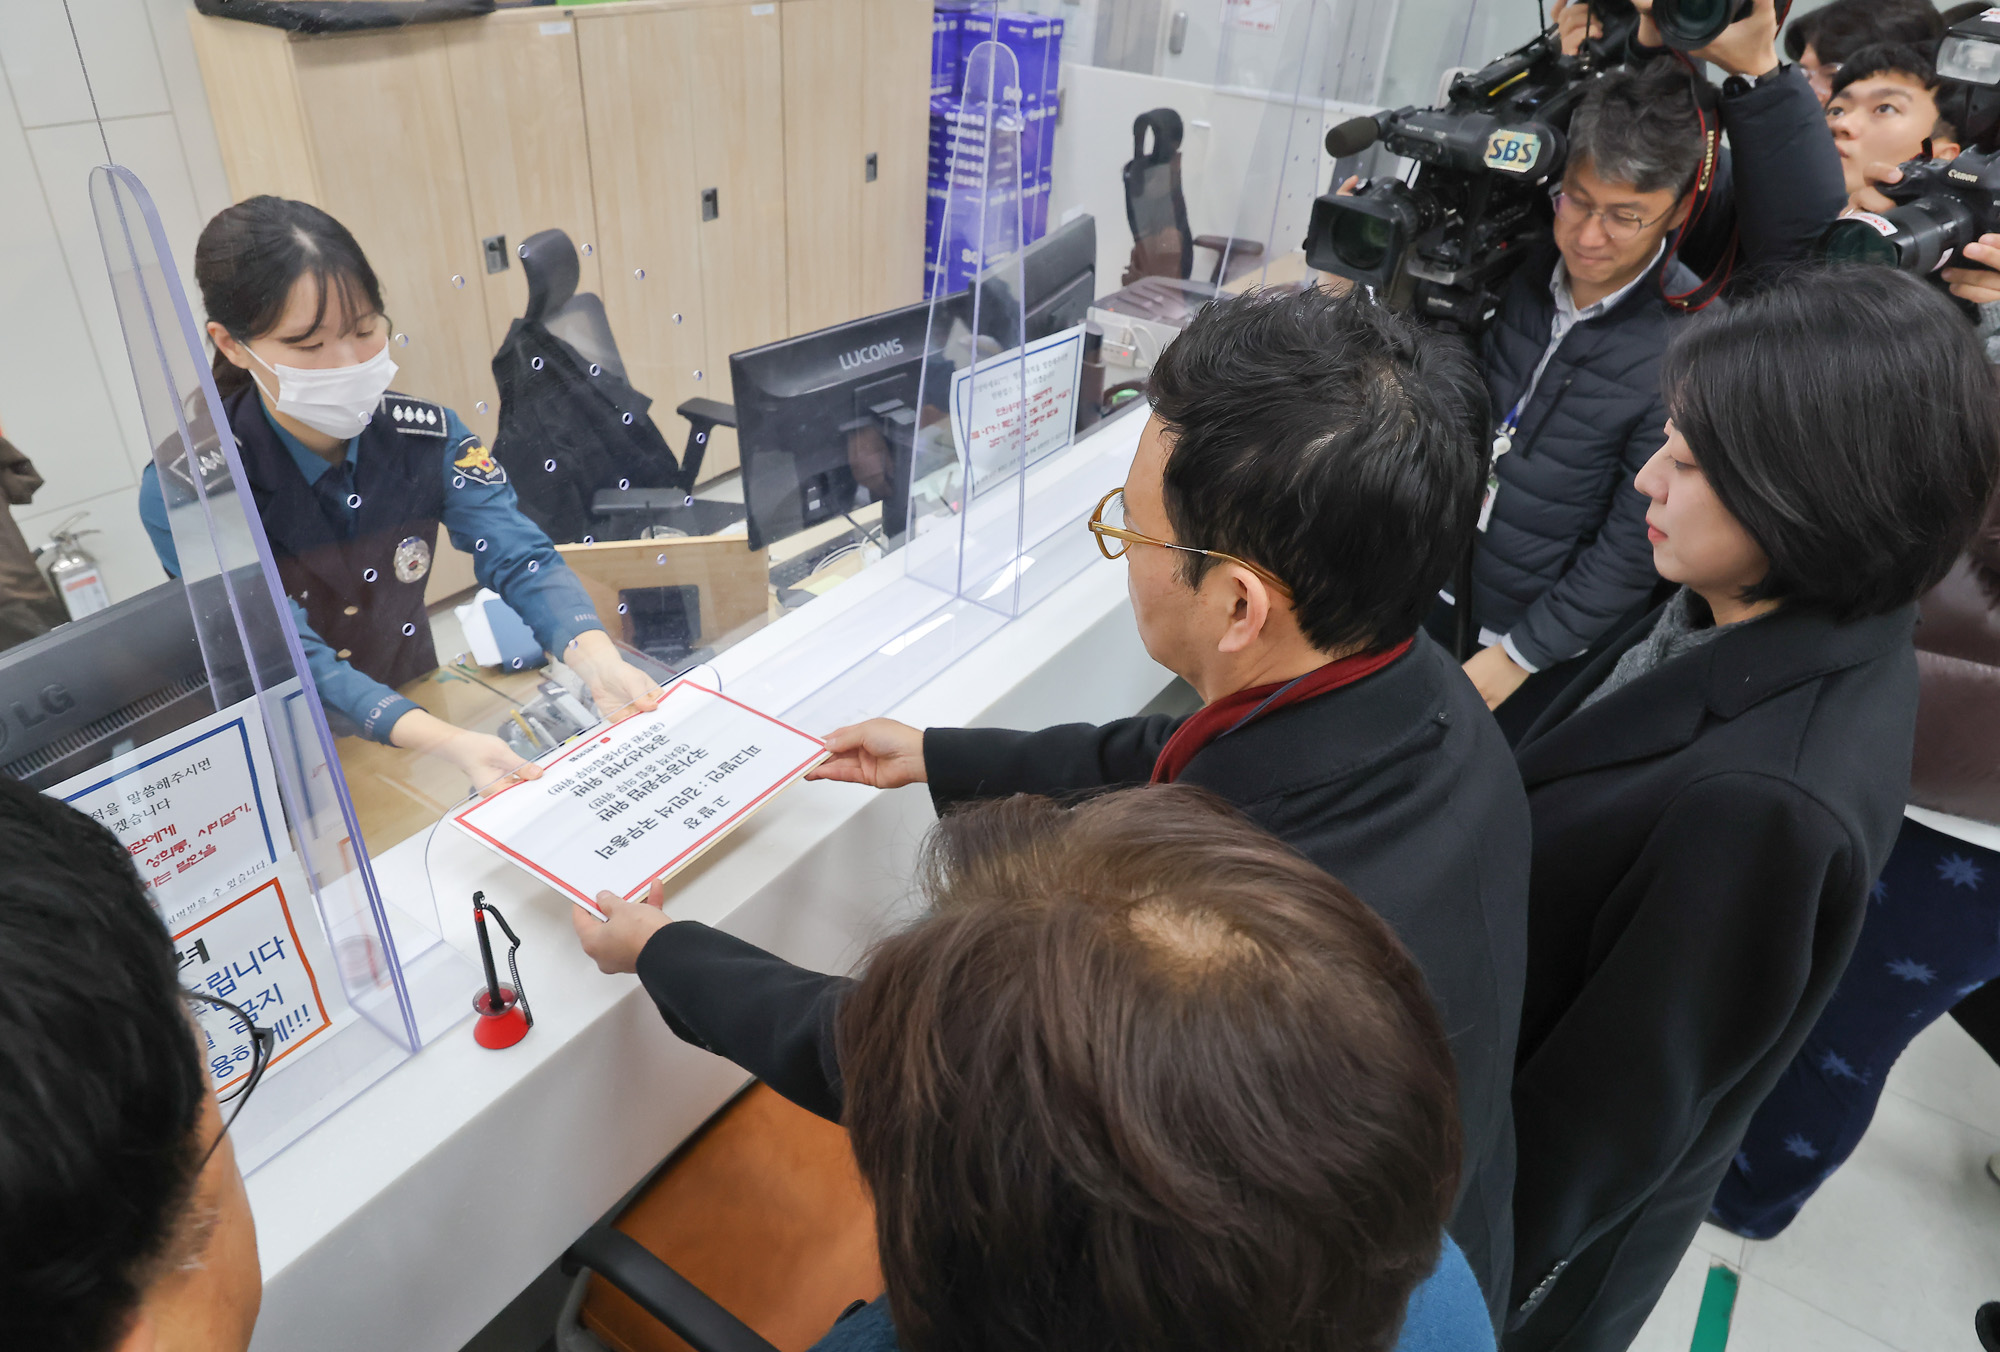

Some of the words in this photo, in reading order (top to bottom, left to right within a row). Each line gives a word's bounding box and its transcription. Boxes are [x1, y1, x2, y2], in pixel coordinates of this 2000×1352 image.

[1488, 138, 1536, 164] SBS
[1699, 130, 1715, 191] Canon
[1948, 168, 1978, 184] Canon
[838, 338, 904, 371] LUCOMS
[10, 684, 76, 730] LG
[600, 734, 671, 780] 공직선거법
[626, 748, 709, 802] 국가공무원법
[704, 744, 762, 784] 피고발인
[127, 757, 212, 805] 말씀해주시면
[569, 777, 603, 798] 위반
[106, 798, 171, 834] 겠습니다
[595, 800, 630, 822] 위반
[653, 786, 703, 819] 김민석
[127, 824, 177, 856] 관에게
[593, 817, 659, 860] 국무총리
